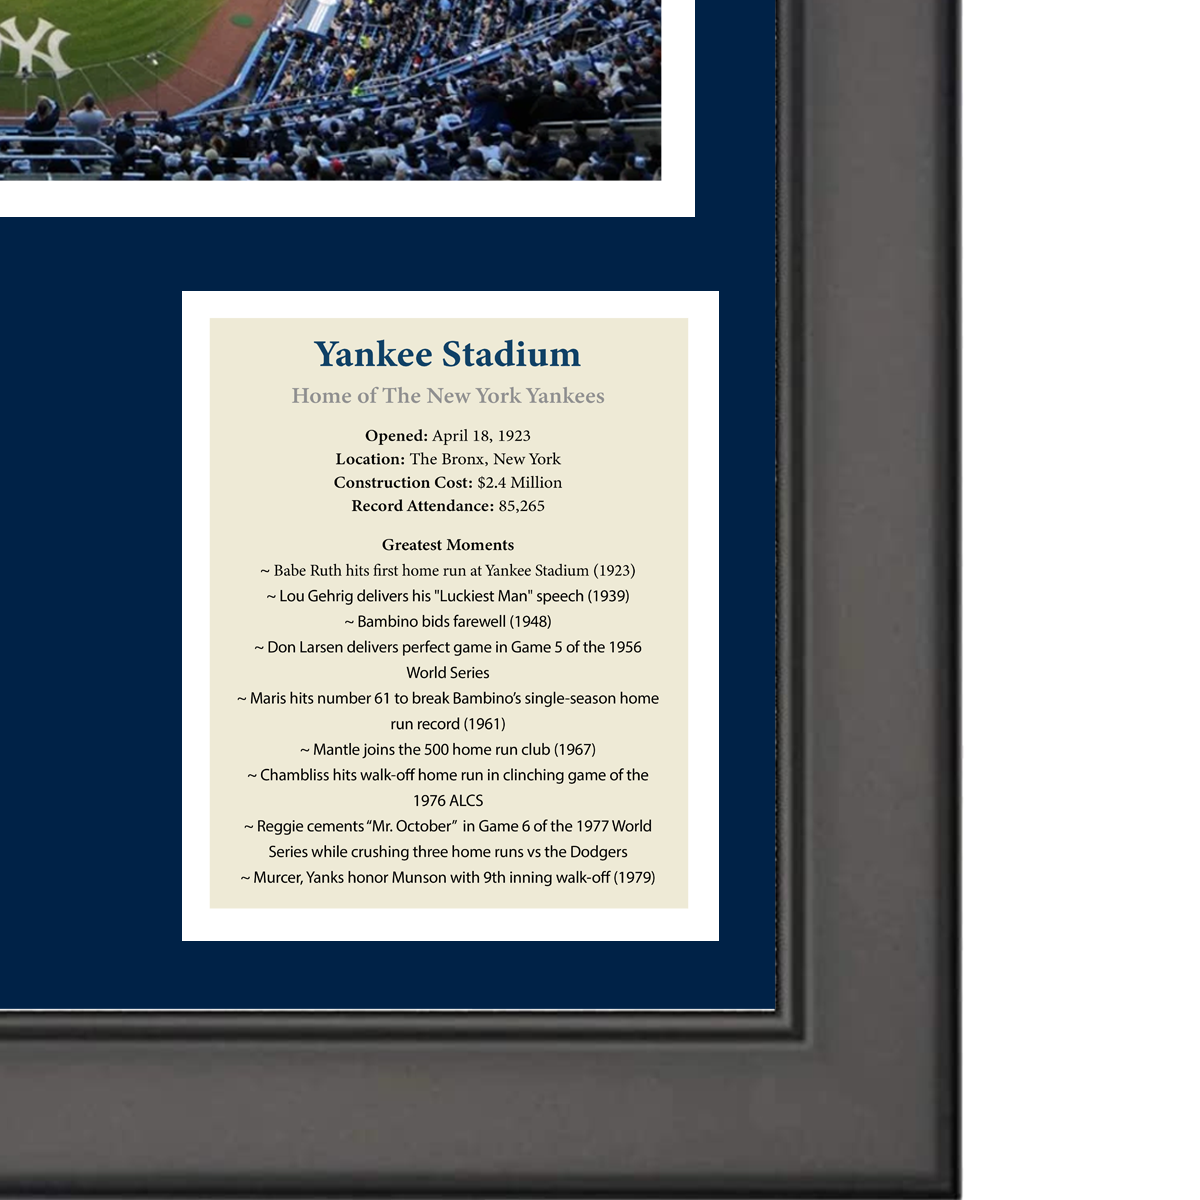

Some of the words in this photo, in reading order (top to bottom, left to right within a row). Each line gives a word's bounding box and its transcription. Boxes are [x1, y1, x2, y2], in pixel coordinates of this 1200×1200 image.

[314, 339, 432, 367] Yankee
[443, 339, 581, 367] Stadium
[292, 388, 351, 403] Home
[358, 387, 379, 403] of
[383, 387, 420, 403] The
[427, 388, 471, 403] New
[476, 387, 522, 403] York
[526, 387, 604, 403] Yankees
[365, 429, 427, 445] Opened:
[432, 429, 468, 445] April
[474, 430, 493, 443] 18,
[499, 430, 530, 441] 1923
[336, 453, 404, 465] Location:
[410, 452, 437, 465] The
[442, 453, 488, 466] Bronx,
[493, 453, 525, 465] New
[529, 452, 561, 465] York
[334, 476, 430, 488] Construction
[435, 476, 472, 488] Cost:
[478, 476, 506, 489] $2.4
[510, 476, 562, 488] Million
[352, 499, 403, 512] Record
[407, 499, 493, 511] Attendance:
[499, 500, 545, 513] 85,265
[382, 539, 442, 551] Greatest
[446, 539, 514, 551] Moments
[274, 564, 306, 576] Babe
[310, 564, 342, 576] Ruth
[346, 564, 369, 576] hits
[373, 563, 398, 576] first
[402, 564, 439, 576] home
[443, 568, 466, 576] run
[471, 566, 482, 576] at
[485, 564, 531, 576] Yankee
[535, 564, 589, 576] Stadium
[594, 563, 635, 579] (1923)
[280, 590, 304, 602] Lou
[308, 589, 353, 605] Gehrig
[357, 589, 408, 602] delivers
[413, 589, 431, 602] his
[435, 589, 494, 602] "Luckiest
[498, 590, 532, 602] Man"
[537, 589, 583, 605] speech
[588, 590, 629, 604] (1939)
[358, 615, 418, 627] Bambino
[422, 615, 450, 627] bids
[453, 614, 505, 627] farewell
[510, 615, 551, 629] (1948)
[268, 641, 295, 653] Don
[300, 641, 343, 653] Larsen
[347, 640, 398, 653] delivers
[403, 640, 450, 656] perfect
[454, 644, 492, 656] game
[496, 641, 507, 653] in
[511, 641, 551, 653] Game
[555, 641, 562, 653] 5
[566, 640, 580, 653] of
[583, 640, 605, 653] the
[610, 641, 642, 653] 1956
[406, 666, 446, 679] World
[450, 666, 489, 679] Series
[251, 692, 286, 704] Maris
[290, 691, 314, 704] hits
[318, 691, 371, 704] number
[375, 692, 388, 704] 61
[394, 693, 408, 704] to
[413, 691, 450, 704] break
[453, 691, 521, 704] Bambino’s
[525, 691, 616, 707] single-season
[620, 691, 659, 704] home
[391, 721, 413, 730] run
[418, 717, 459, 730] record
[464, 717, 505, 731] (1961)
[314, 743, 360, 755] Mantle
[362, 743, 395, 759] joins
[398, 743, 421, 755] the
[425, 743, 449, 755] 500
[453, 743, 491, 755] home
[496, 746, 517, 755] run
[522, 743, 550, 755] club
[555, 743, 595, 757] (1967)
[261, 768, 329, 781] Chambliss
[333, 768, 357, 781] hits
[360, 768, 415, 781] walk-off
[419, 768, 457, 781] home
[462, 772, 483, 781] run
[488, 769, 499, 781] in
[503, 768, 564, 784] clinching
[568, 772, 606, 784] game
[610, 768, 624, 781] of
[626, 768, 649, 781] the
[414, 795, 446, 806] 1976
[449, 794, 483, 806] ALCS
[258, 820, 303, 835] Reggie
[307, 821, 364, 832] cements
[367, 820, 393, 832] “Mr.
[396, 819, 457, 832] October”
[463, 820, 475, 832] in
[479, 820, 519, 832] Game
[522, 820, 530, 832] 6
[534, 819, 548, 832] of
[550, 819, 573, 832] the
[577, 820, 609, 832] 1977
[612, 819, 651, 832] World
[269, 845, 308, 858] Series
[311, 845, 348, 858] while
[351, 845, 409, 861] crushing
[413, 845, 448, 858] three
[452, 845, 491, 858] home
[495, 849, 524, 858] runs
[527, 849, 541, 858] vs
[544, 845, 567, 858] the
[571, 845, 627, 861] Dodgers
[254, 871, 303, 885] Murcer,
[306, 871, 344, 883] Yanks
[348, 871, 388, 883] honor
[392, 871, 446, 883] Munson
[450, 871, 479, 883] with
[484, 871, 505, 883] 9th
[510, 871, 552, 886] inning
[556, 870, 611, 883] walk-off
[614, 871, 655, 885] (1979)
